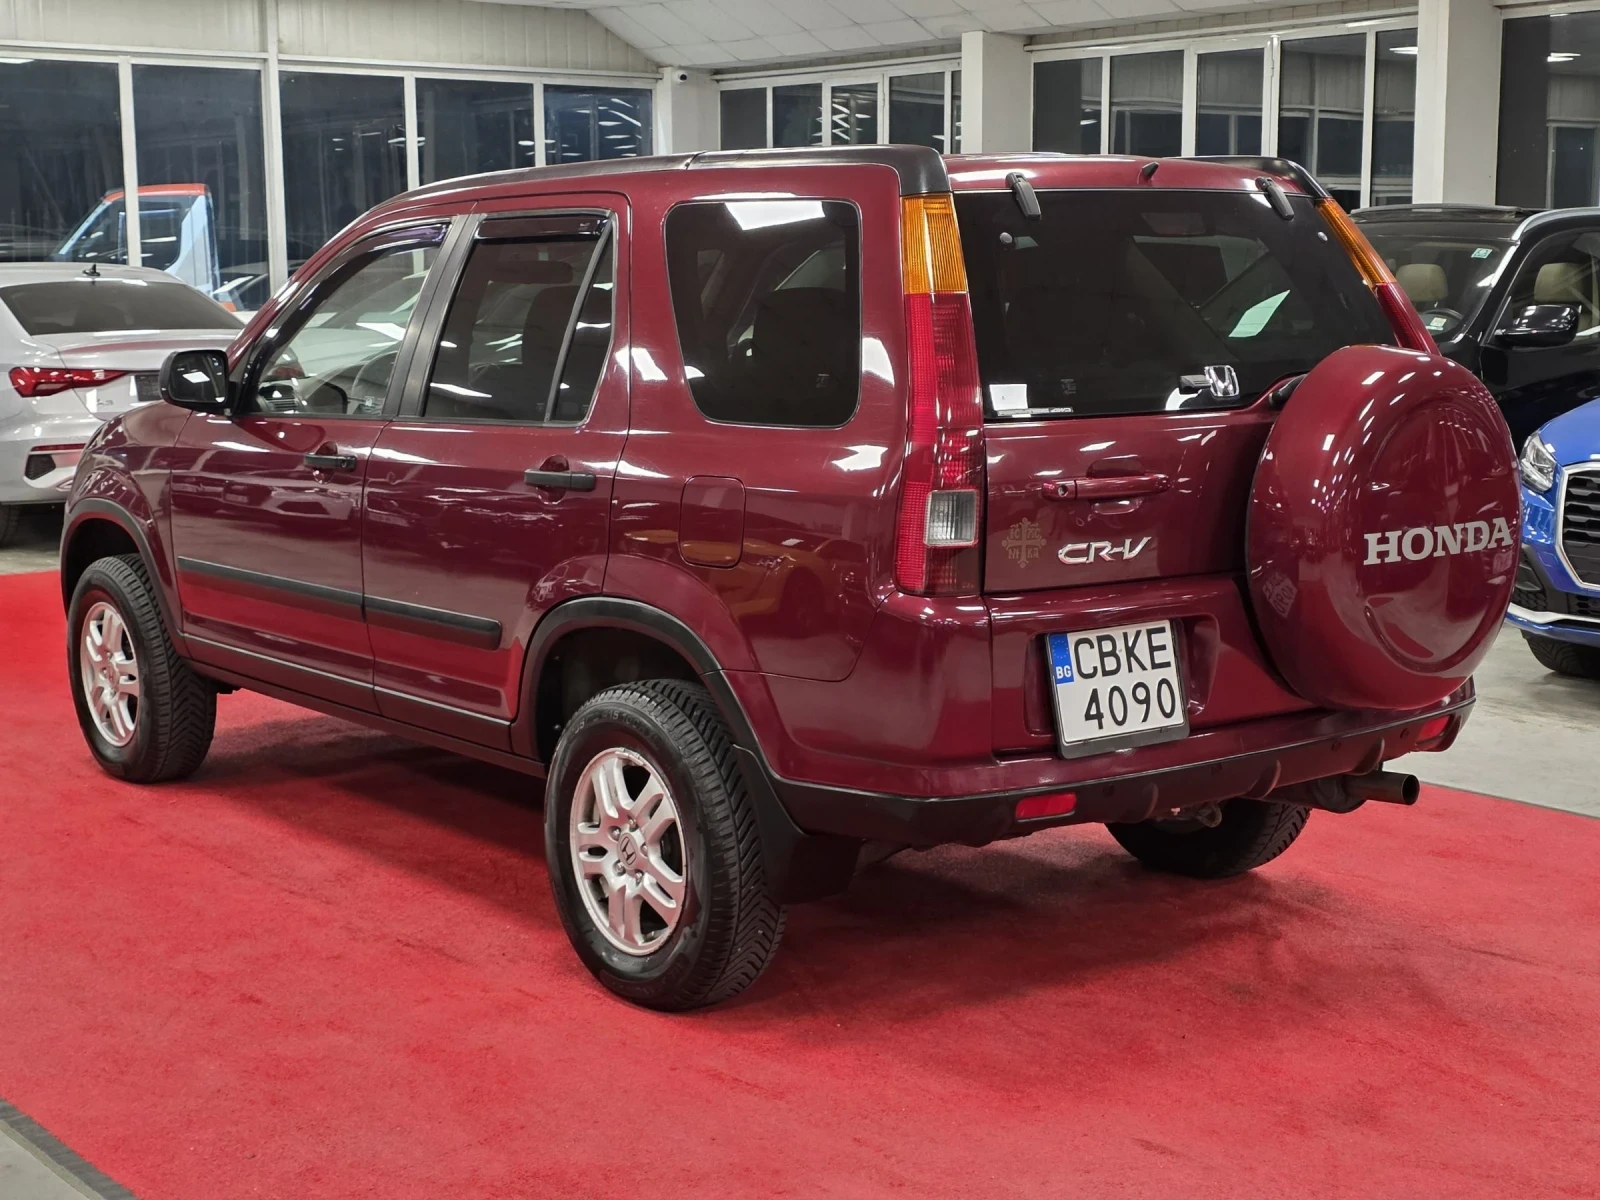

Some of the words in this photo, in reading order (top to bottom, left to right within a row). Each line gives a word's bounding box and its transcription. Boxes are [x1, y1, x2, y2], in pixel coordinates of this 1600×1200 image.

[1058, 536, 1152, 565] CR-V
[1363, 517, 1513, 566] HONDA
[1055, 664, 1072, 679] BG
[1073, 626, 1172, 679] CBKE
[1084, 677, 1176, 730] 4090
